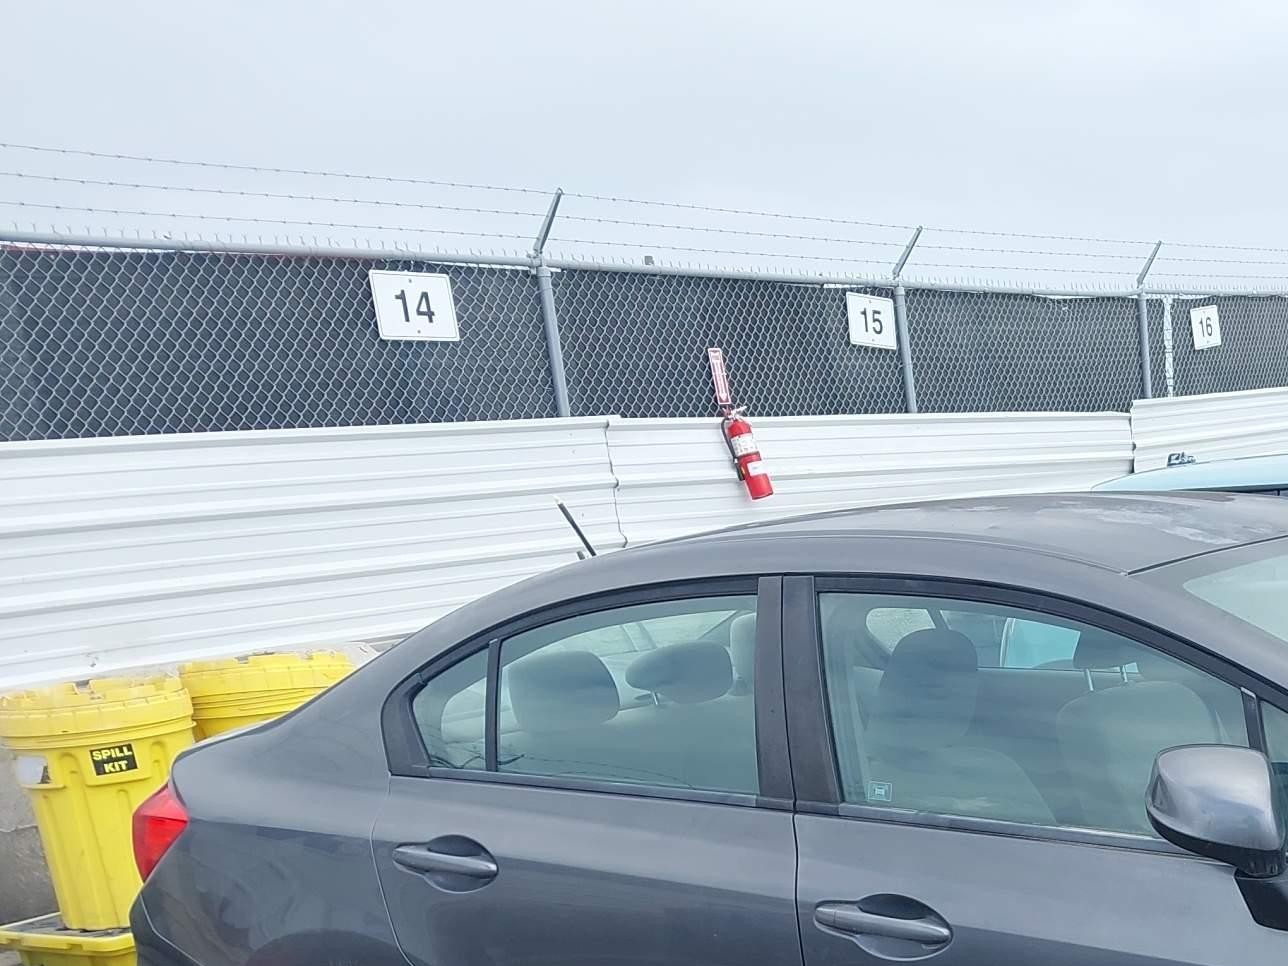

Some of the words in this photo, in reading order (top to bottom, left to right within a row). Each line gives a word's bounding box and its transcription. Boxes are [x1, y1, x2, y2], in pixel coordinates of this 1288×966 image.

[395, 290, 435, 323] 14
[860, 307, 883, 335] 15
[1198, 316, 1213, 338] 16
[92, 746, 133, 761] SPILL
[103, 760, 128, 773] KIT
